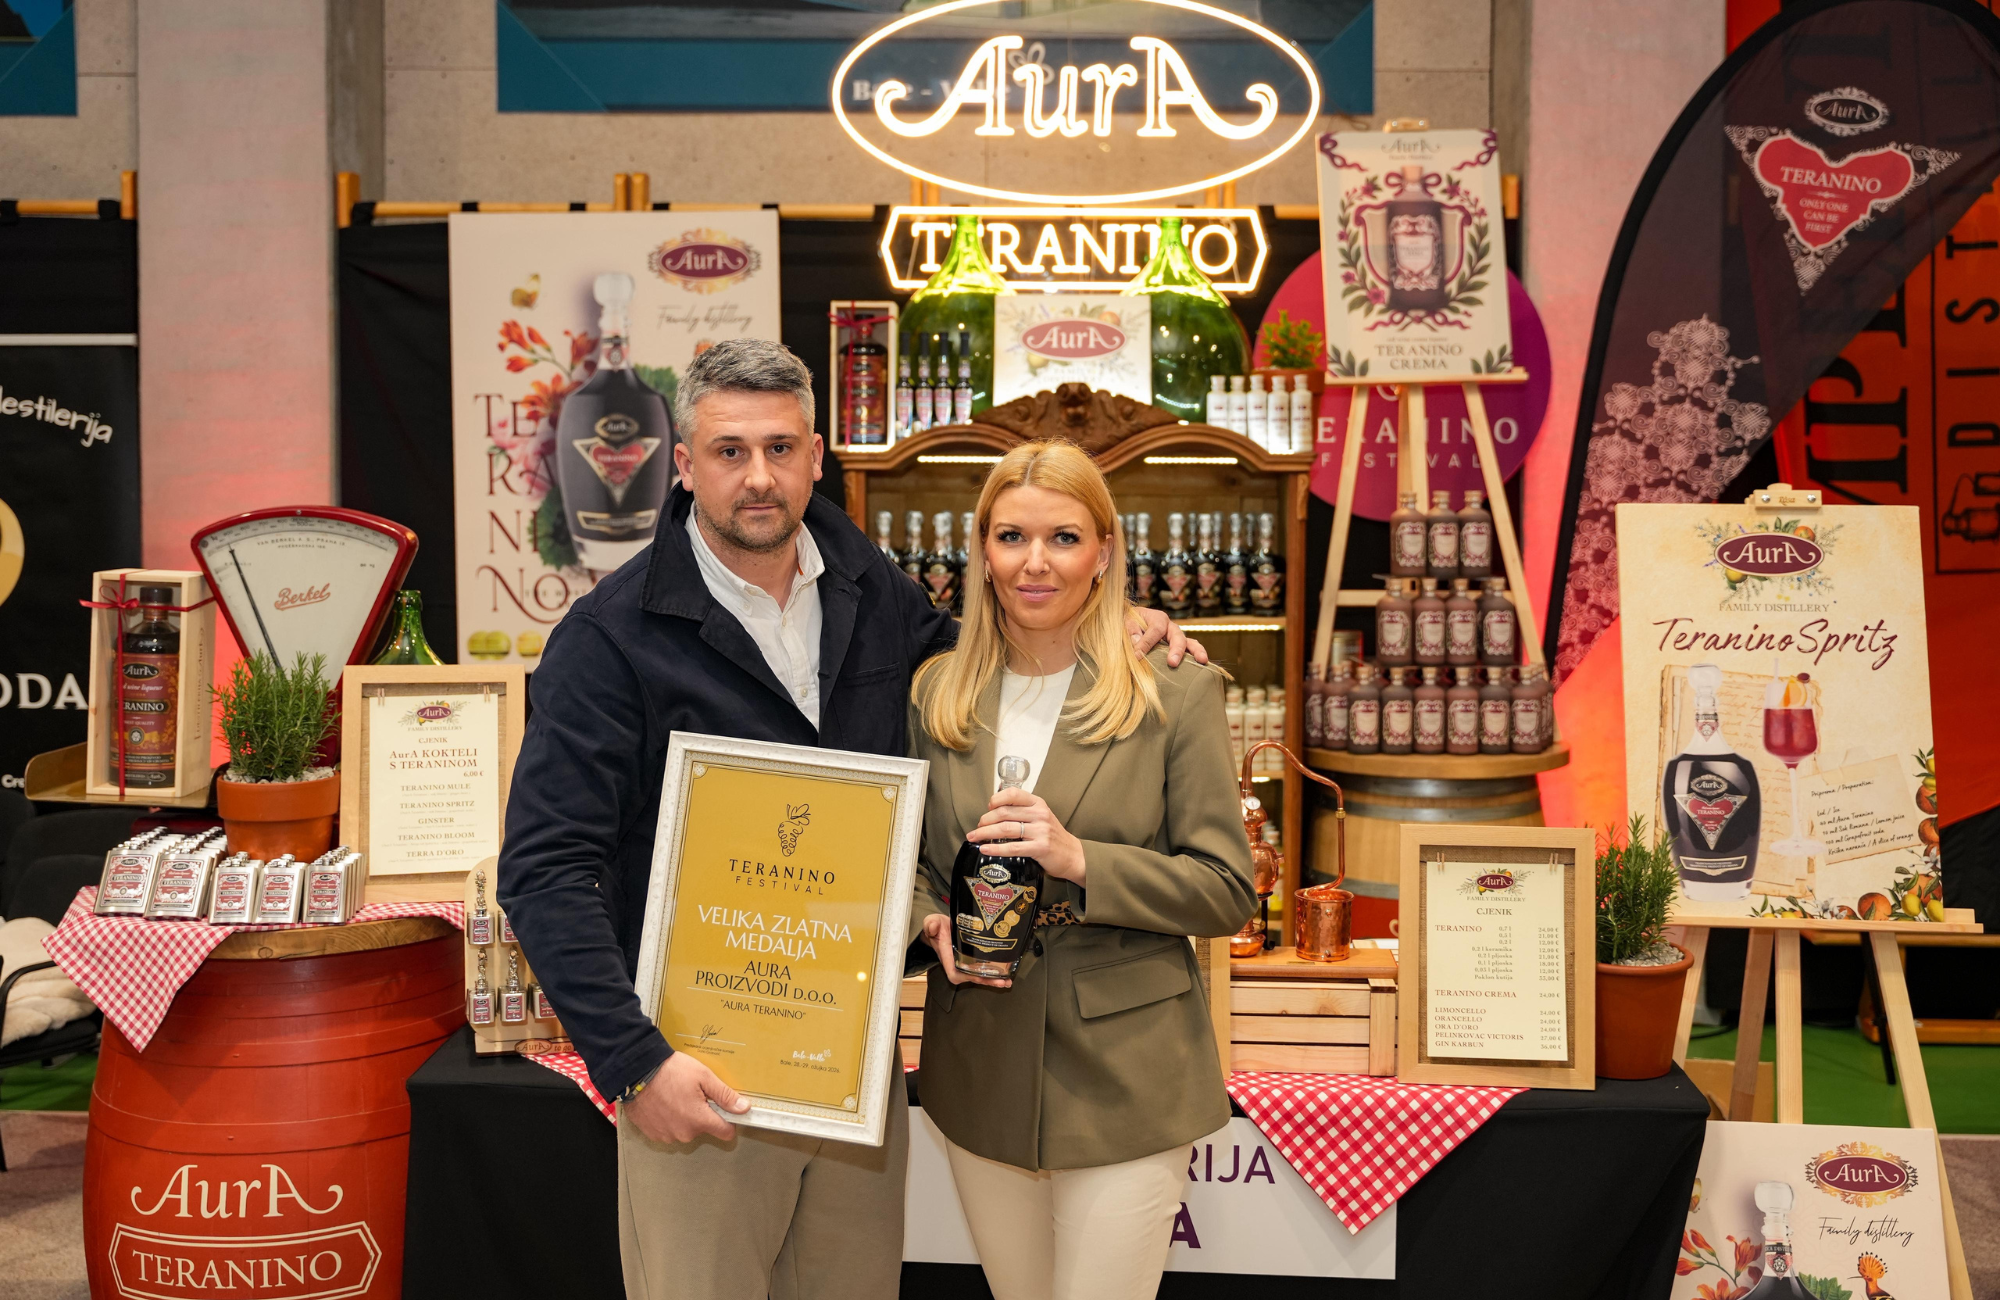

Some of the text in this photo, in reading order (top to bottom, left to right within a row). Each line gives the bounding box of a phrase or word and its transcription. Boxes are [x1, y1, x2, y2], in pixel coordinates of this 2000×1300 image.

[874, 35, 1279, 140] AurA
[1815, 101, 1877, 121] AurA
[1780, 165, 1882, 194] TERANINO
[1799, 197, 1849, 213] ONLY ONE
[1803, 209, 1840, 224] CAN BE
[1805, 222, 1833, 235] FIRST
[666, 248, 744, 271] AurA
[1026, 326, 1121, 350] AurA
[1374, 343, 1463, 357] TERANINO
[1389, 358, 1447, 370] CREMA
[0, 385, 113, 447] estilerija
[1722, 541, 1816, 565] AurA
[274, 583, 331, 611] Berkel
[1719, 603, 1830, 613] FAMILY DISTILLERY
[123, 663, 158, 676] AurA
[418, 707, 450, 718] AurA
[389, 748, 478, 759] AurA KOKTELI
[389, 759, 478, 770] S TERANINOM
[400, 784, 445, 792] TERANINO
[446, 800, 475, 808] SPRITZ
[397, 831, 475, 841] TERANINO BLOOM
[406, 848, 464, 858] TERRA D'ORO
[729, 858, 835, 885] TERANINO
[983, 868, 1007, 878] AurA
[735, 875, 824, 896] FESTIVAL
[1478, 876, 1513, 887] AurA
[977, 889, 1010, 900] TERANINO
[1476, 908, 1512, 916] CJENIK
[698, 904, 853, 943] VELIKA ZLATNA
[1435, 924, 1482, 933] TERANINO
[725, 930, 817, 962] MEDALJA
[744, 960, 792, 981] AURA
[695, 970, 837, 1005] PROIZVODI D.O.O.
[1435, 989, 1482, 997] TERANINO
[1484, 990, 1517, 998] CREMA
[1487, 1033, 1524, 1041] VICTORIS
[516, 1040, 550, 1051] AurA
[1823, 1163, 1900, 1184] AurA
[130, 1164, 344, 1219] AurA
[131, 1249, 343, 1290] TERANINO
